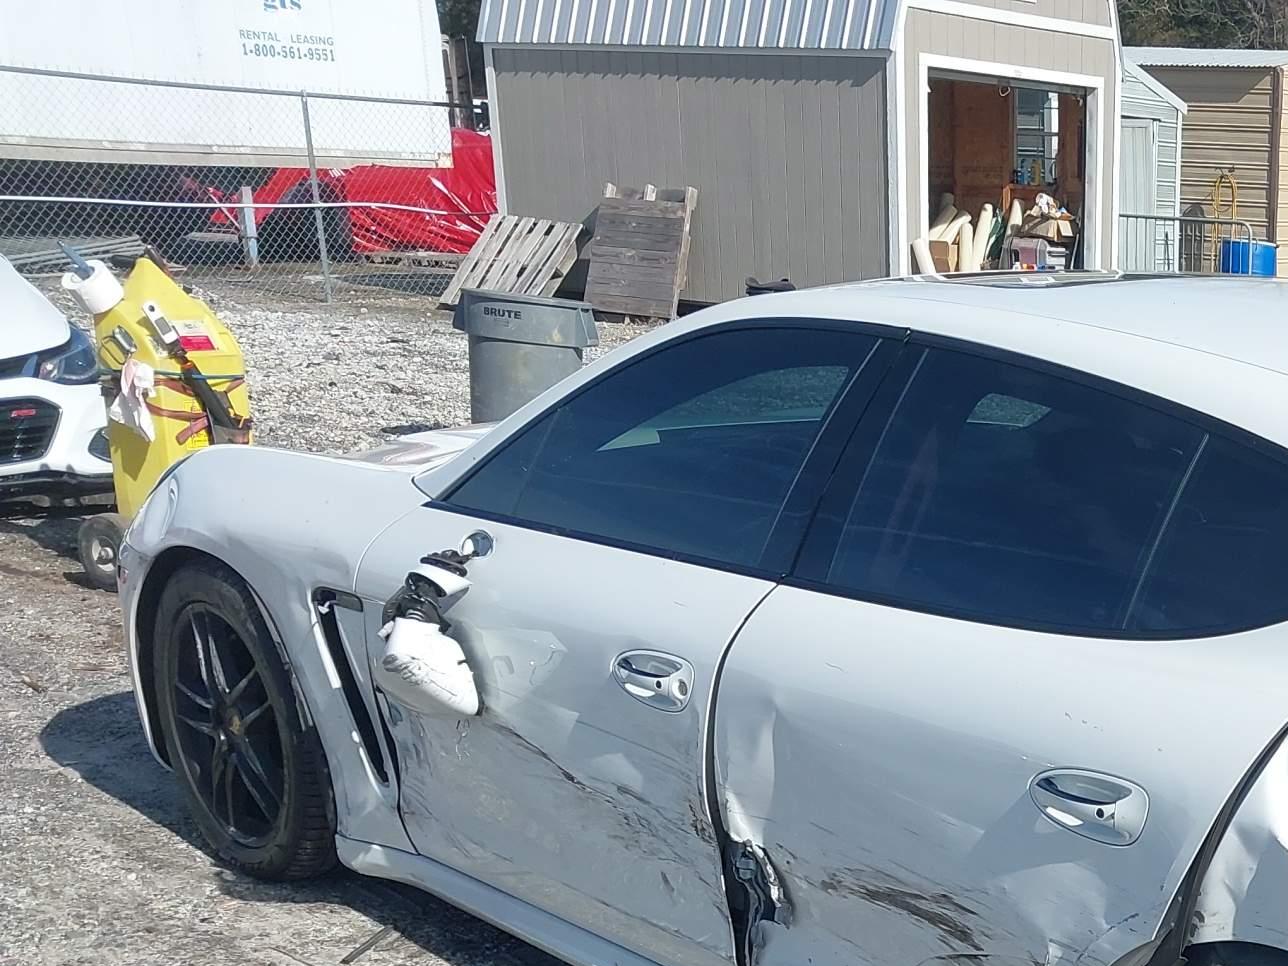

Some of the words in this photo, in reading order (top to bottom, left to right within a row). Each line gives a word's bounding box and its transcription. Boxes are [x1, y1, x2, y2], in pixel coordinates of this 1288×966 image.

[239, 29, 281, 42] RENTAL
[290, 33, 335, 46] LEASING
[483, 306, 522, 320] BRUTE
